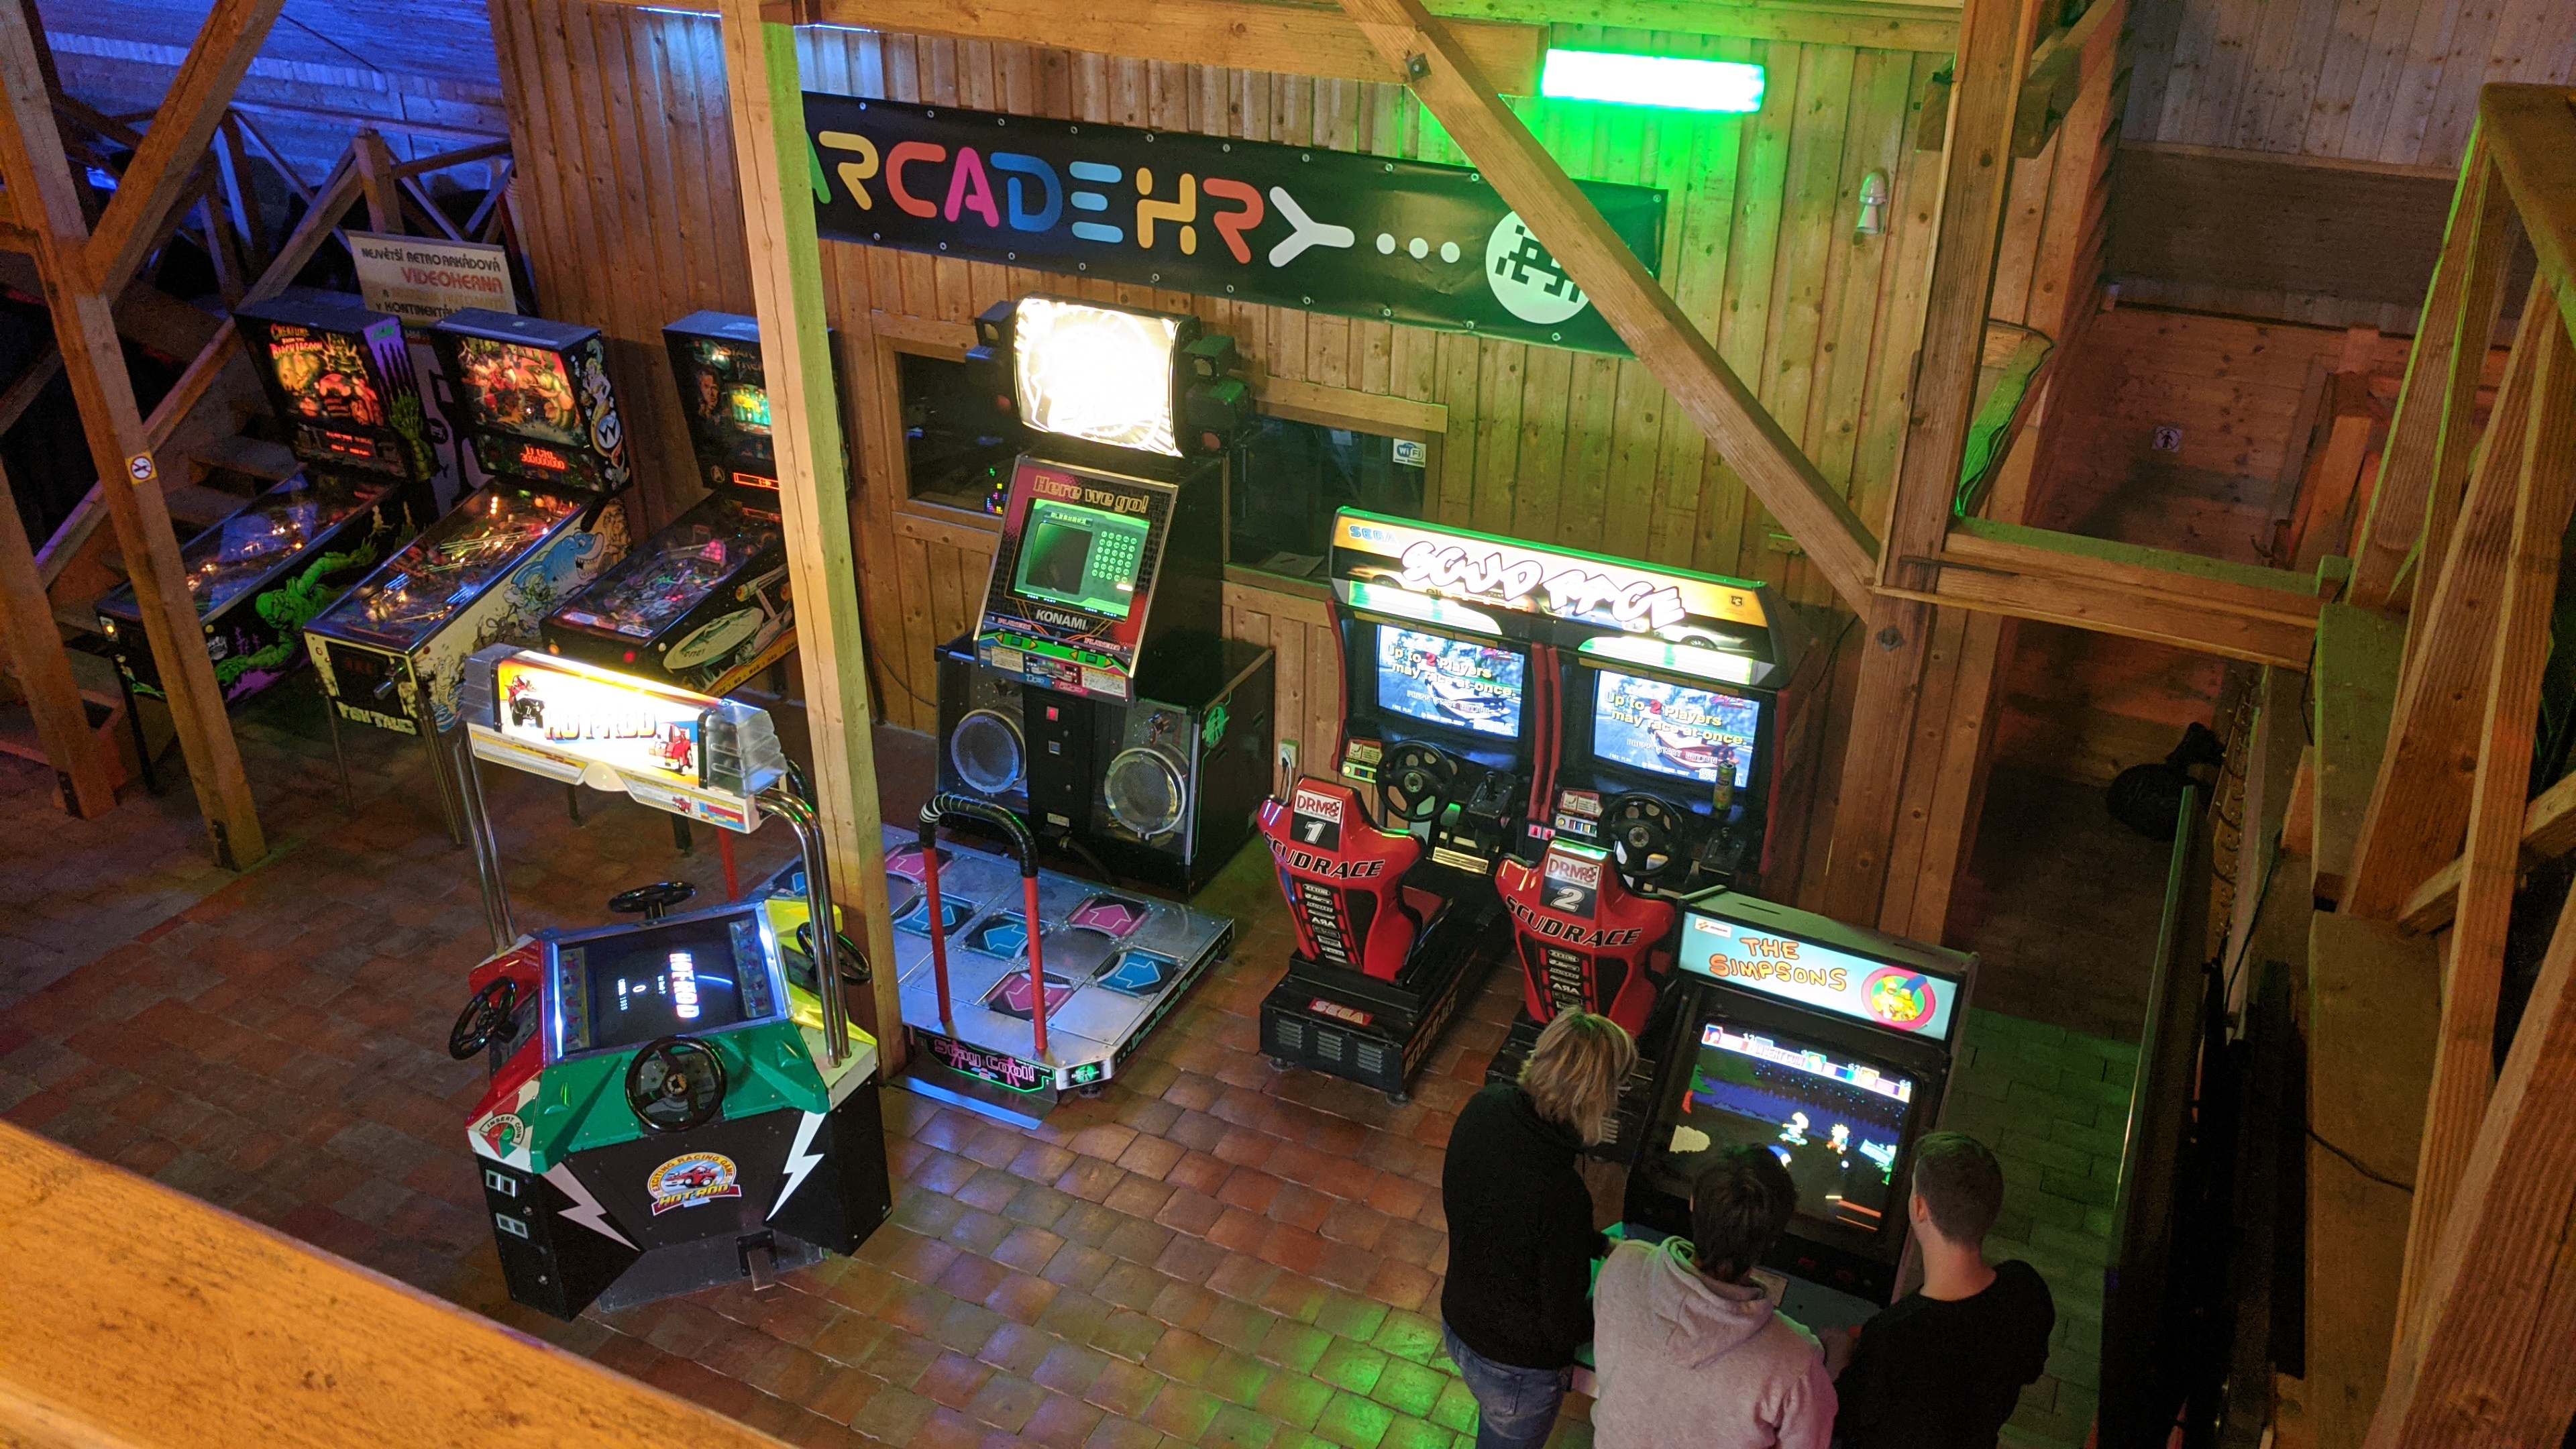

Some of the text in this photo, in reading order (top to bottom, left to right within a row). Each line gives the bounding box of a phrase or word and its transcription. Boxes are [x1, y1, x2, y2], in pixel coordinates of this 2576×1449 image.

[407, 252, 441, 265] RETRO
[401, 267, 503, 294] VIDEOHERNA
[1033, 474, 1150, 514] Here we go!
[1348, 525, 1397, 544] SEGA
[1400, 540, 1686, 630] SCUD RACE
[1036, 608, 1087, 631] KONAMI
[1386, 643, 1493, 678] Up to 2 Players
[1392, 661, 1421, 680] may
[1424, 671, 1453, 686] race
[1473, 680, 1517, 697] once.
[1605, 692, 1723, 727] Up to 2 Players
[1611, 709, 1748, 746] may race at once.
[1305, 820, 1326, 845] 1
[1550, 886, 1585, 913] 2
[1739, 936, 1801, 961] THE
[1709, 953, 1847, 991] SIMPSONS
[1311, 1000, 1364, 1024] SEGA
[934, 1040, 981, 1068] Stay
[985, 1055, 1035, 1083] Cool!
[487, 1116, 515, 1128] INSERT
[651, 1154, 733, 1192] EXCITING RACING GAME
